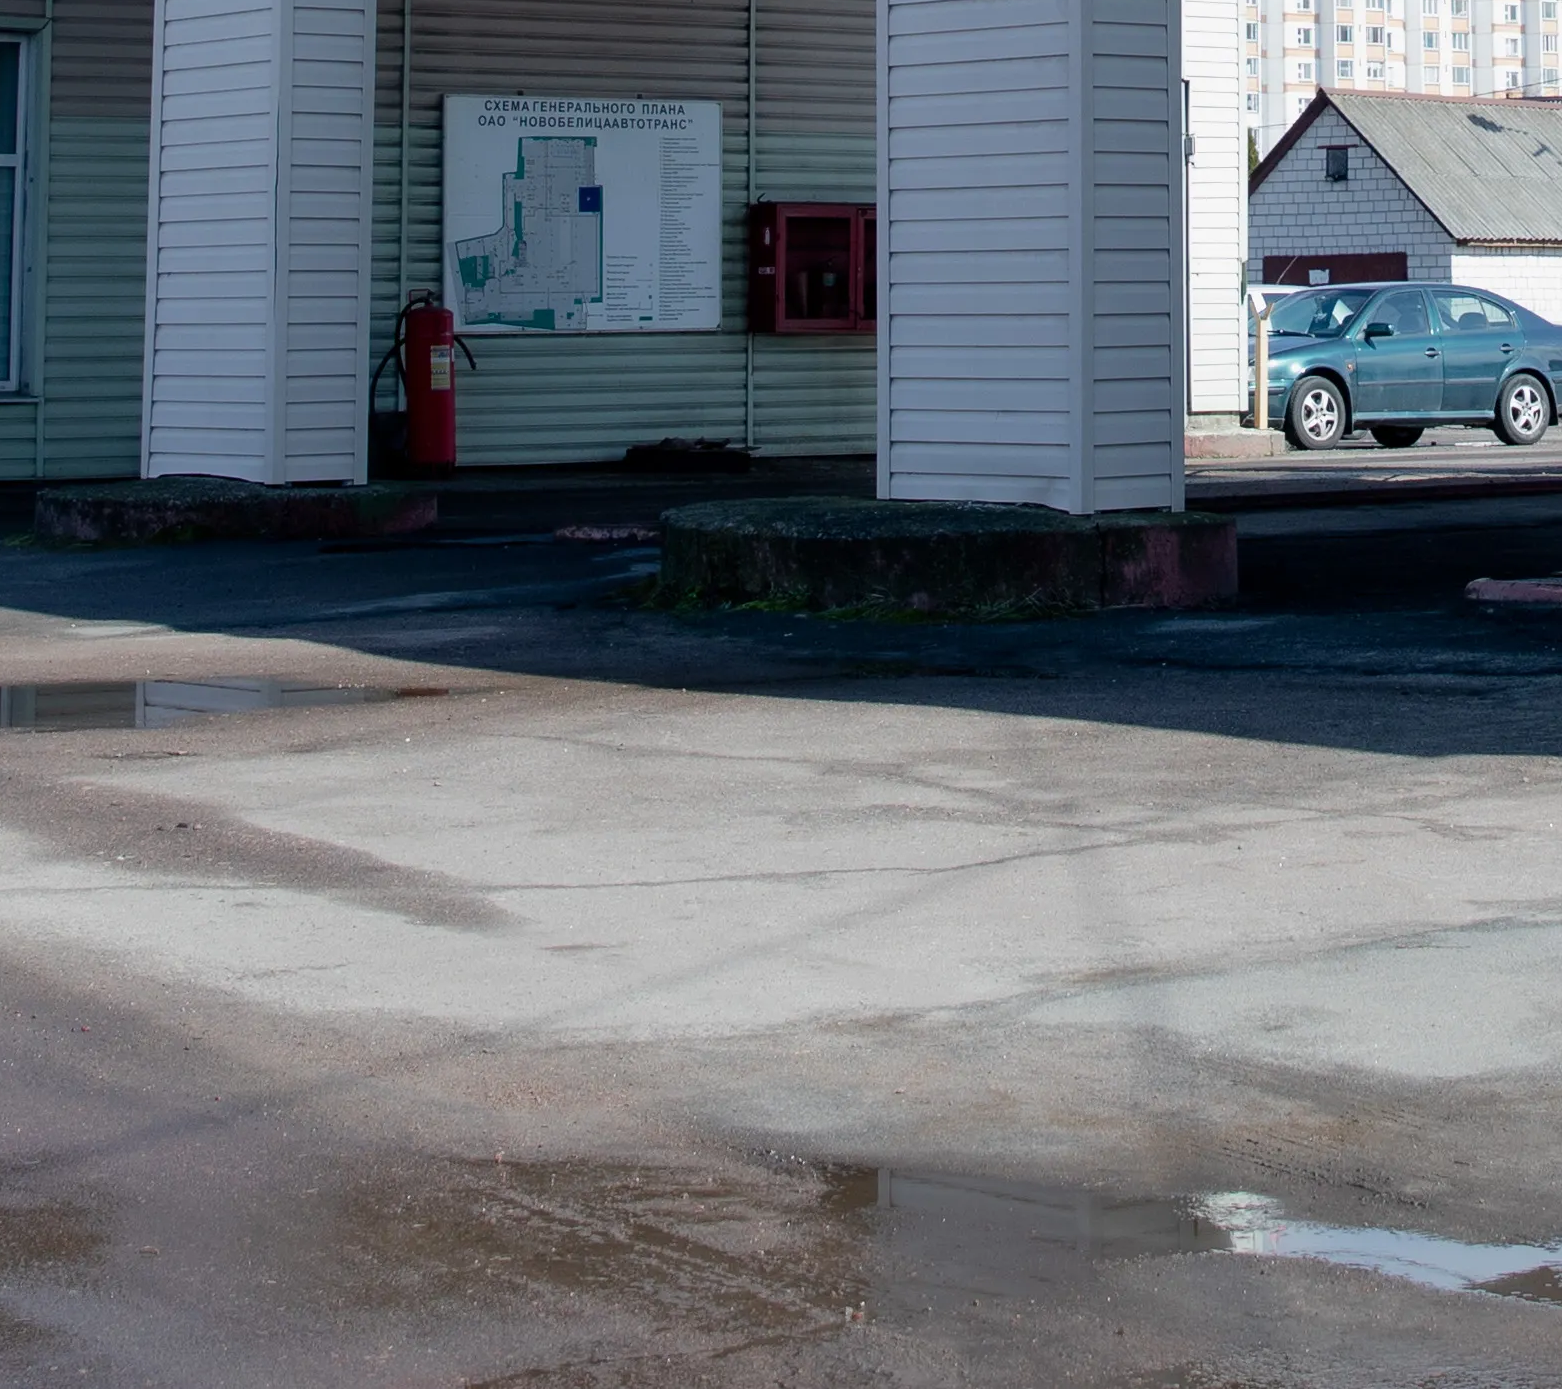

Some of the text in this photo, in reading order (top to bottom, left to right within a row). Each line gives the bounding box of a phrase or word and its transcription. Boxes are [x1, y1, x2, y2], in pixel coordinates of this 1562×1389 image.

[484, 100, 686, 115] СХЕМА ГЕНЕРАЛЬНОГО ПЛАНА
[478, 115, 506, 127] ОАО
